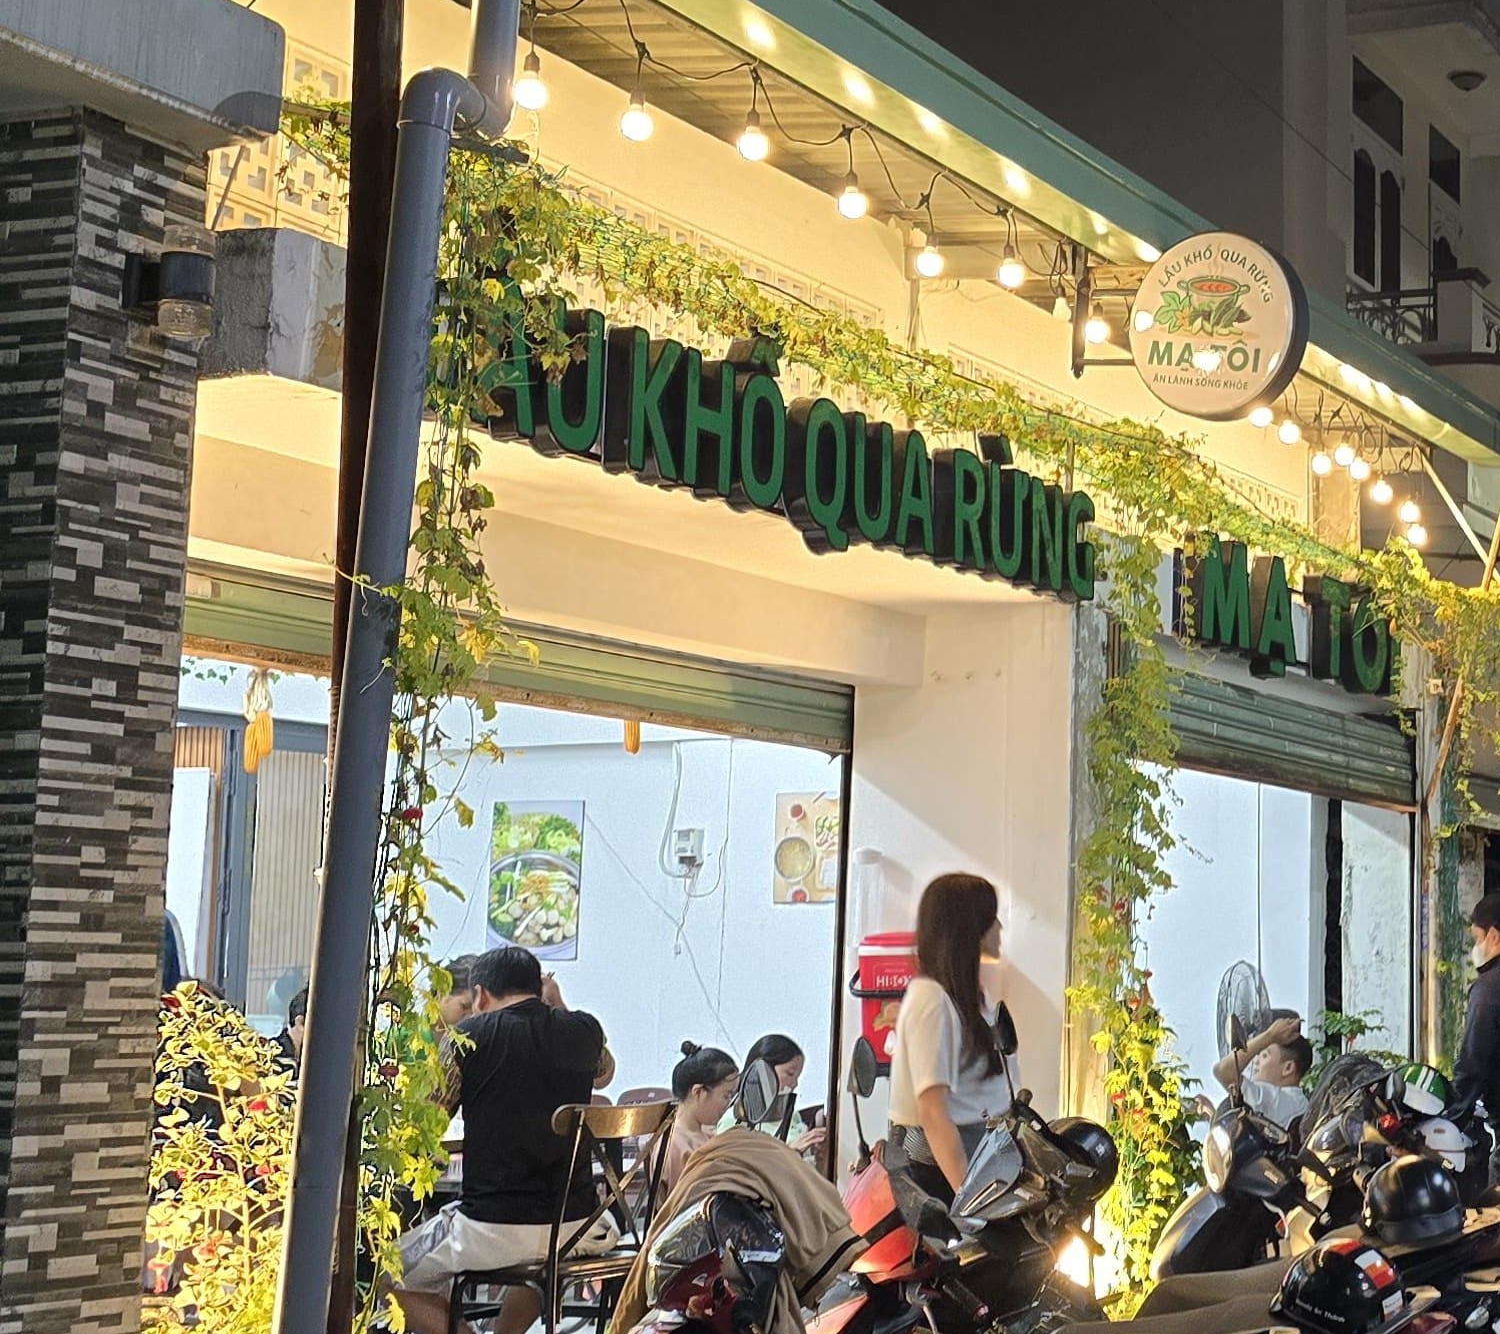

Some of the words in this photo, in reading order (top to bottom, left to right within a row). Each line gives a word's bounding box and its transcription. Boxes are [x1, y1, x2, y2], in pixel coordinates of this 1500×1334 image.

[1220, 249, 1247, 269] QUA
[1147, 340, 1195, 372] MẠ
[805, 397, 935, 556] QUA
[953, 433, 1096, 601] RỪNG
[1201, 531, 1297, 678] MẠ
